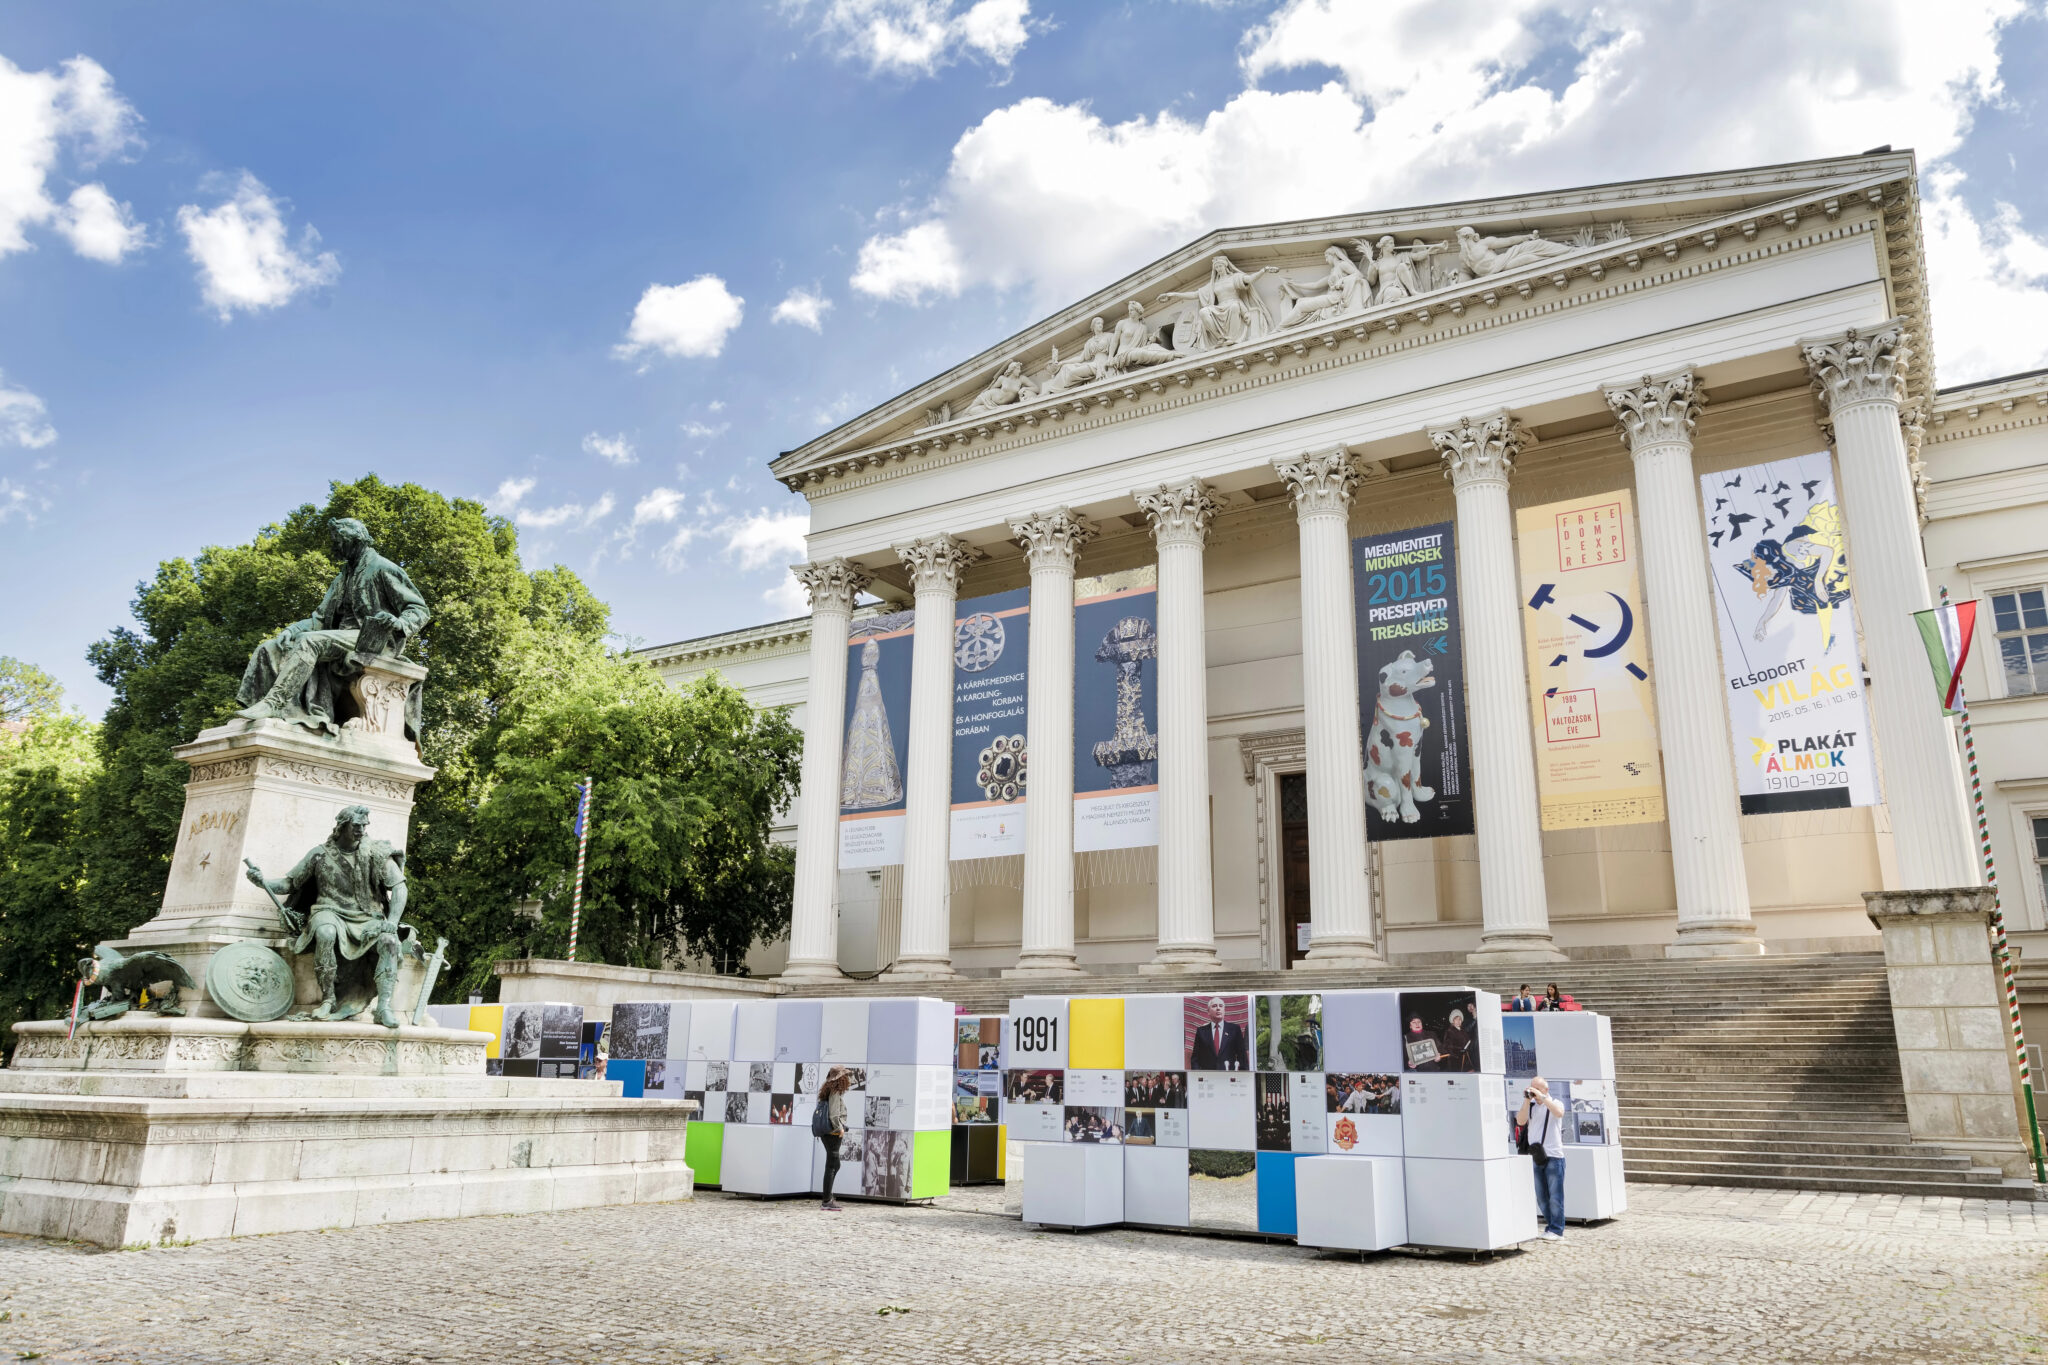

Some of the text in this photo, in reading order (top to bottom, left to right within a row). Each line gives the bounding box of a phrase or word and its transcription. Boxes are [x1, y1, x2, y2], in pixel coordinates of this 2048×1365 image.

[1364, 534, 1442, 558] MEGMENTETT
[1368, 564, 1446, 605] 2015
[1369, 598, 1448, 622] PRESERVED
[1370, 617, 1448, 641] TREASURES
[963, 673, 1024, 690] KÁRPÁT-MEDENCE
[1731, 659, 1806, 689] ELSODORT
[1562, 695, 1577, 703] 1989
[1753, 664, 1854, 710] VILÁG
[992, 695, 1023, 706] KORBAN
[1768, 710, 1793, 722] 2015.
[1794, 705, 1811, 715] 05.
[1812, 700, 1825, 710] 16.
[1832, 694, 1846, 704] 10.
[1847, 690, 1860, 700] 18.
[972, 706, 1024, 721] HONFOGLALÁS
[956, 725, 990, 736] KORÁBAN
[1778, 730, 1856, 753] PLAKÁT
[1766, 750, 1846, 773] ÁLMOK
[188, 808, 239, 840] ARANY
[1014, 1017, 1057, 1052] 1991
